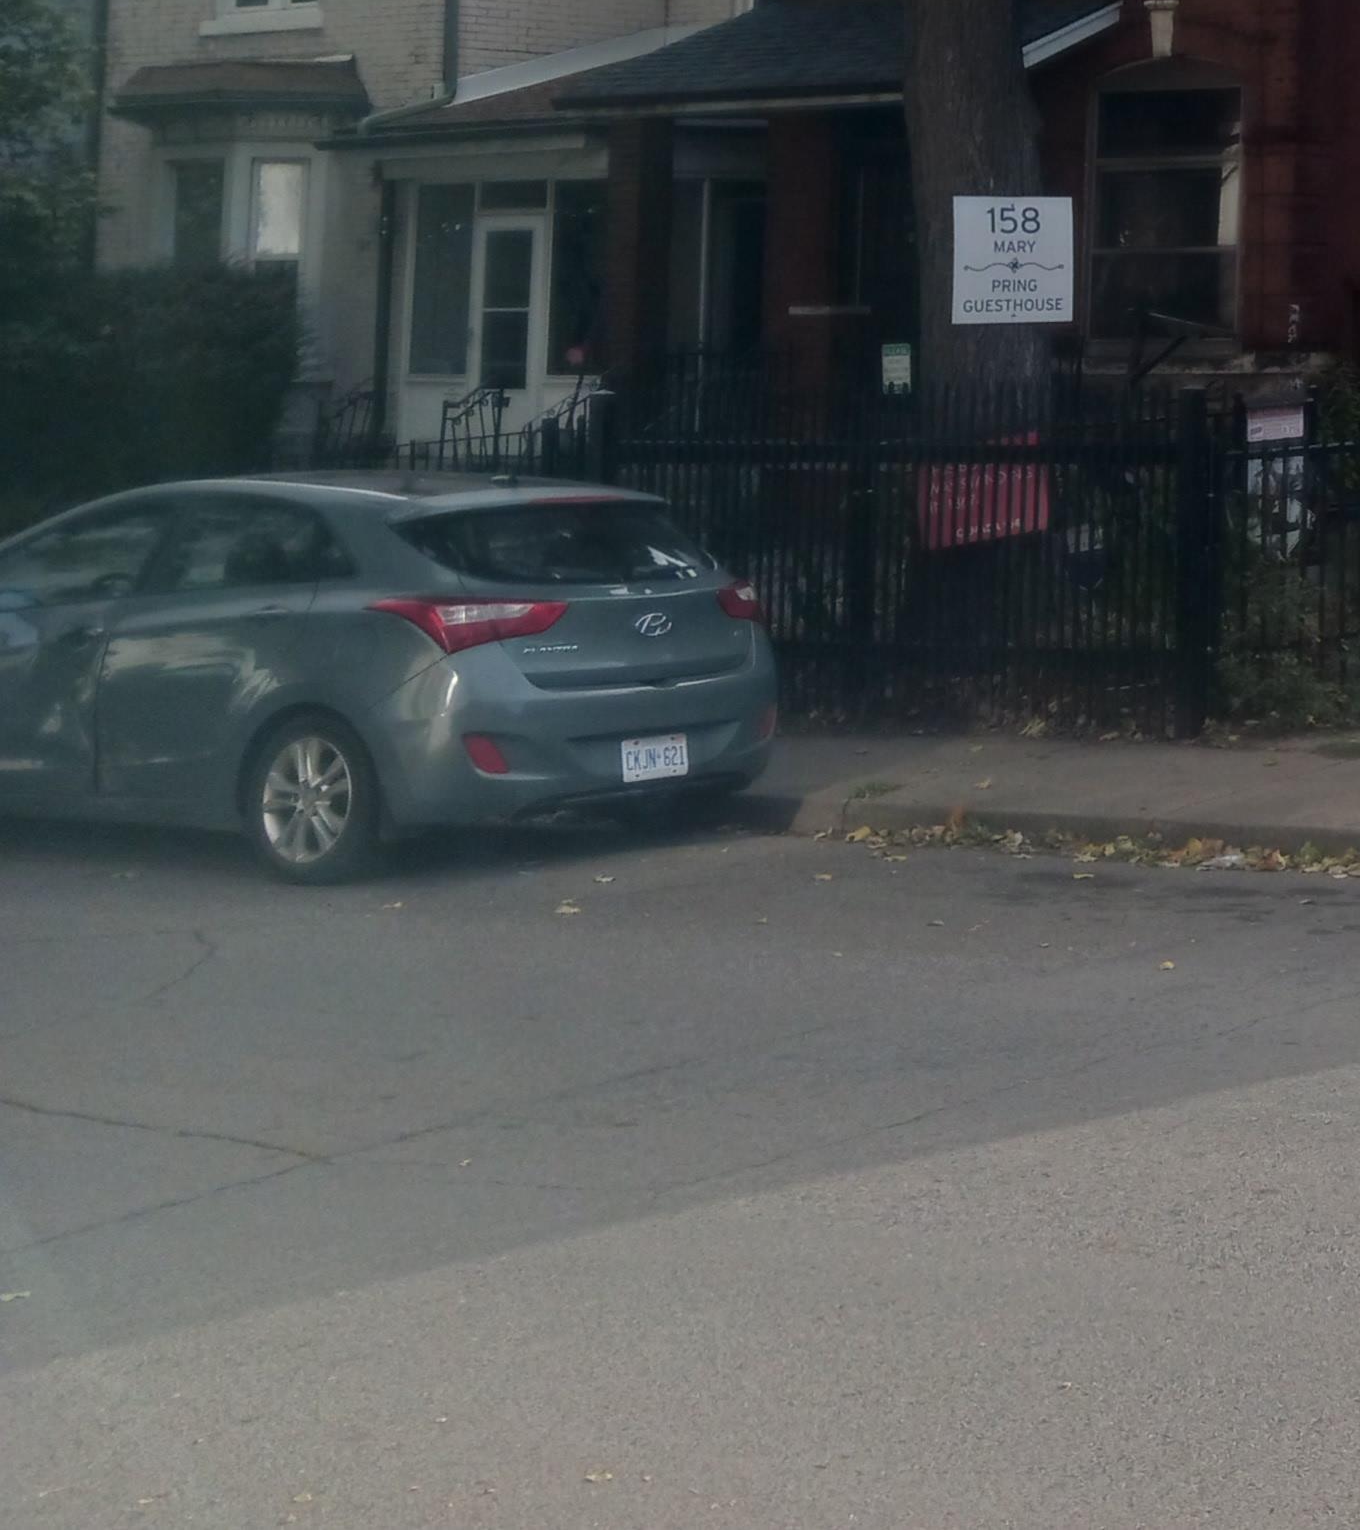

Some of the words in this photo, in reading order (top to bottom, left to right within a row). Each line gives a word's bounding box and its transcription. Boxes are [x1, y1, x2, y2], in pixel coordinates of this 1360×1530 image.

[986, 206, 1041, 234] 158
[993, 240, 1036, 253] MARY
[991, 279, 1038, 293] PRING
[962, 298, 1064, 313] GUESTHOUSE
